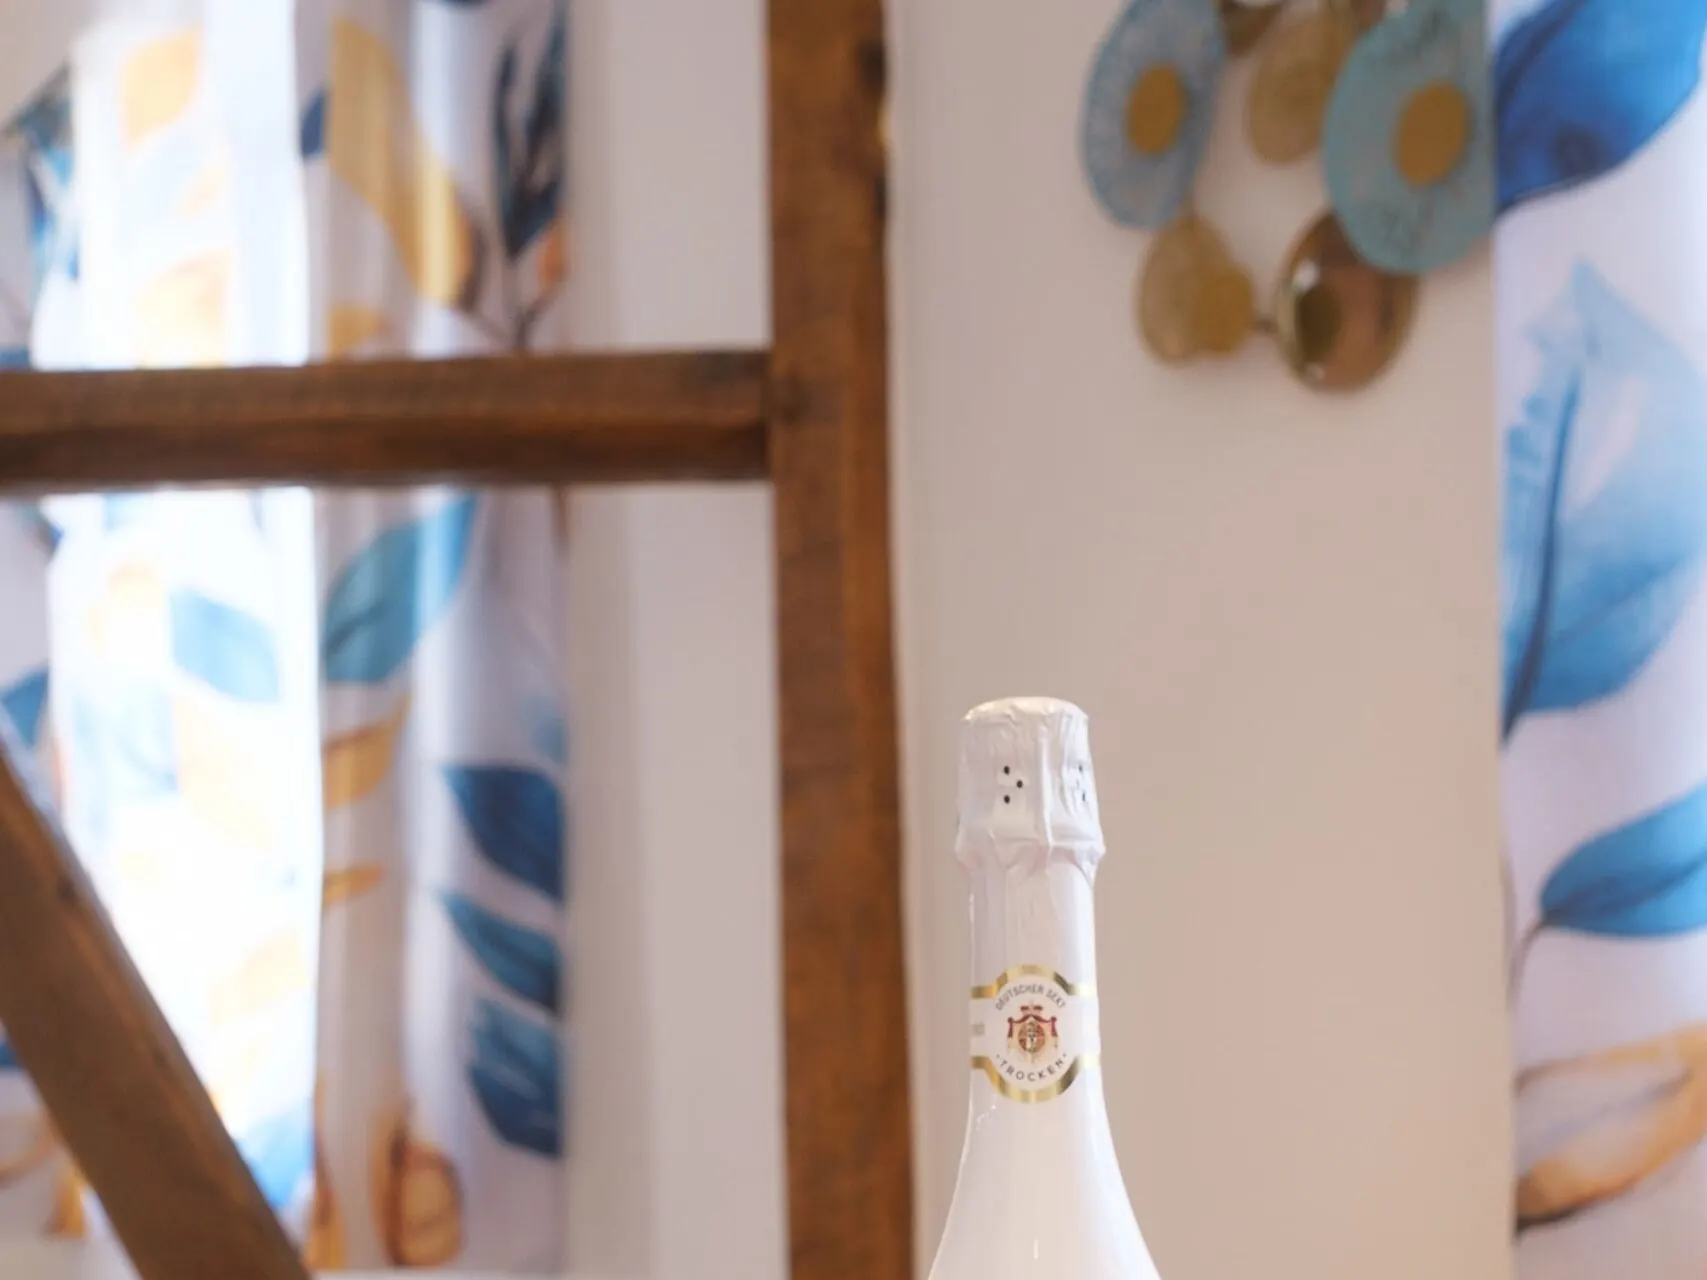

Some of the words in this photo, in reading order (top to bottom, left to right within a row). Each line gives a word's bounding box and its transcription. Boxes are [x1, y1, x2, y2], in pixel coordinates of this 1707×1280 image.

[995, 983, 1044, 1011] DEUTSCHER
[1046, 989, 1066, 1009] SEKT
[1000, 1059, 1064, 1082] TROCKEN
